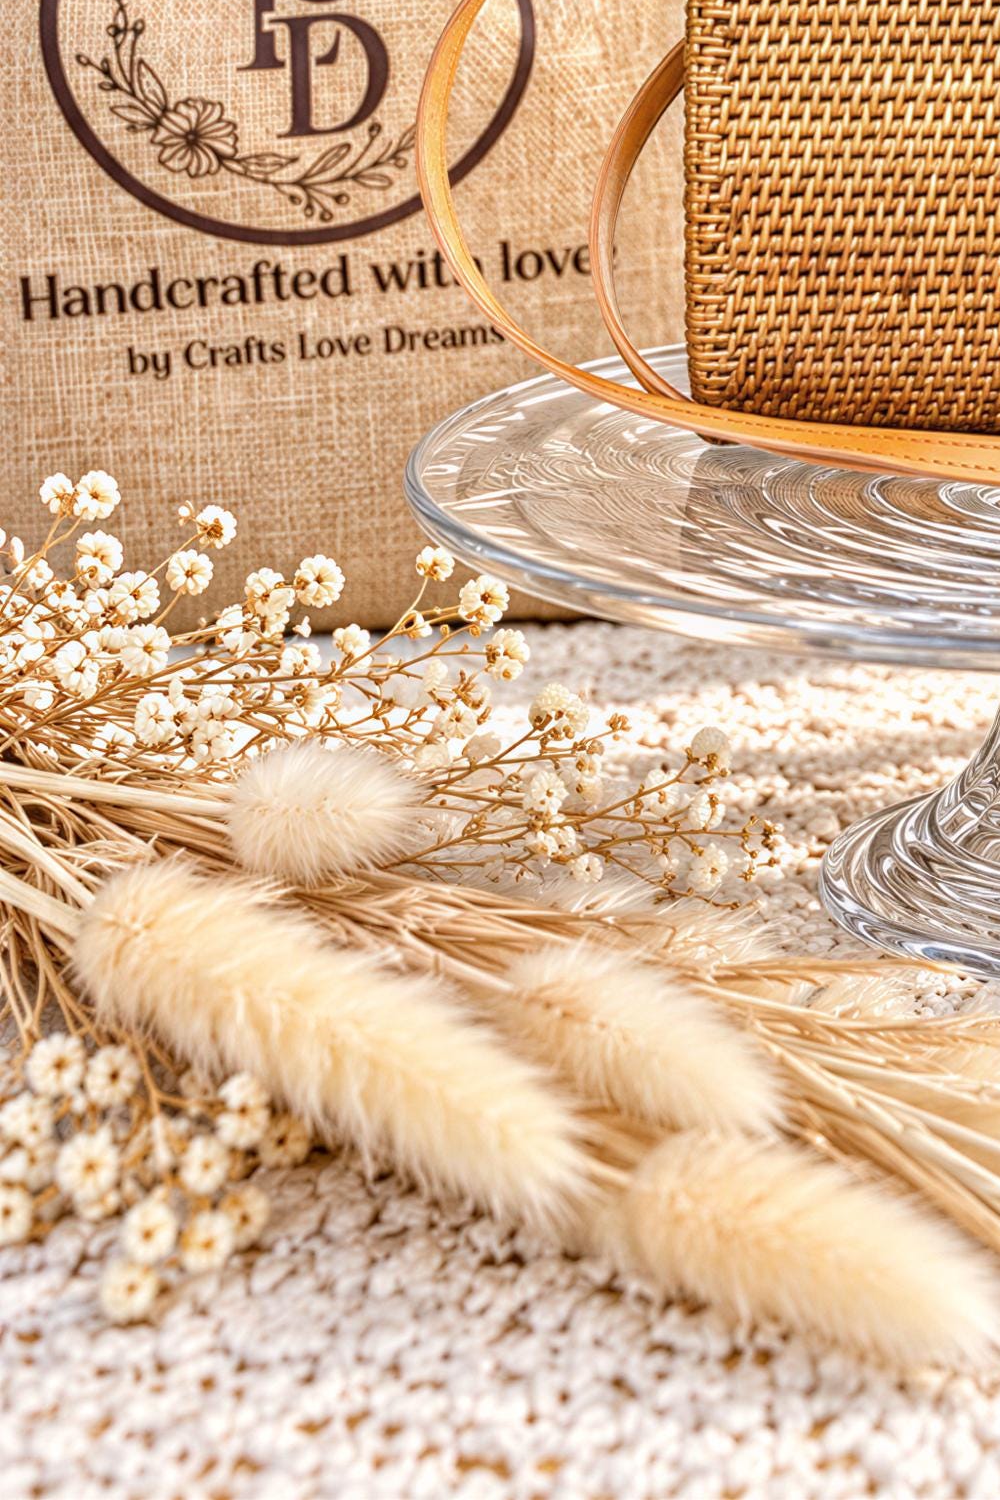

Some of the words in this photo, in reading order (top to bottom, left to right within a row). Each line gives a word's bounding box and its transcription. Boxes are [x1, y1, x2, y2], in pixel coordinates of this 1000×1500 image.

[20, 253, 353, 322] Handcrafted
[127, 346, 172, 380] by
[183, 335, 287, 370] Crafts
[298, 332, 371, 361] Love
[383, 322, 506, 354] Dreams
